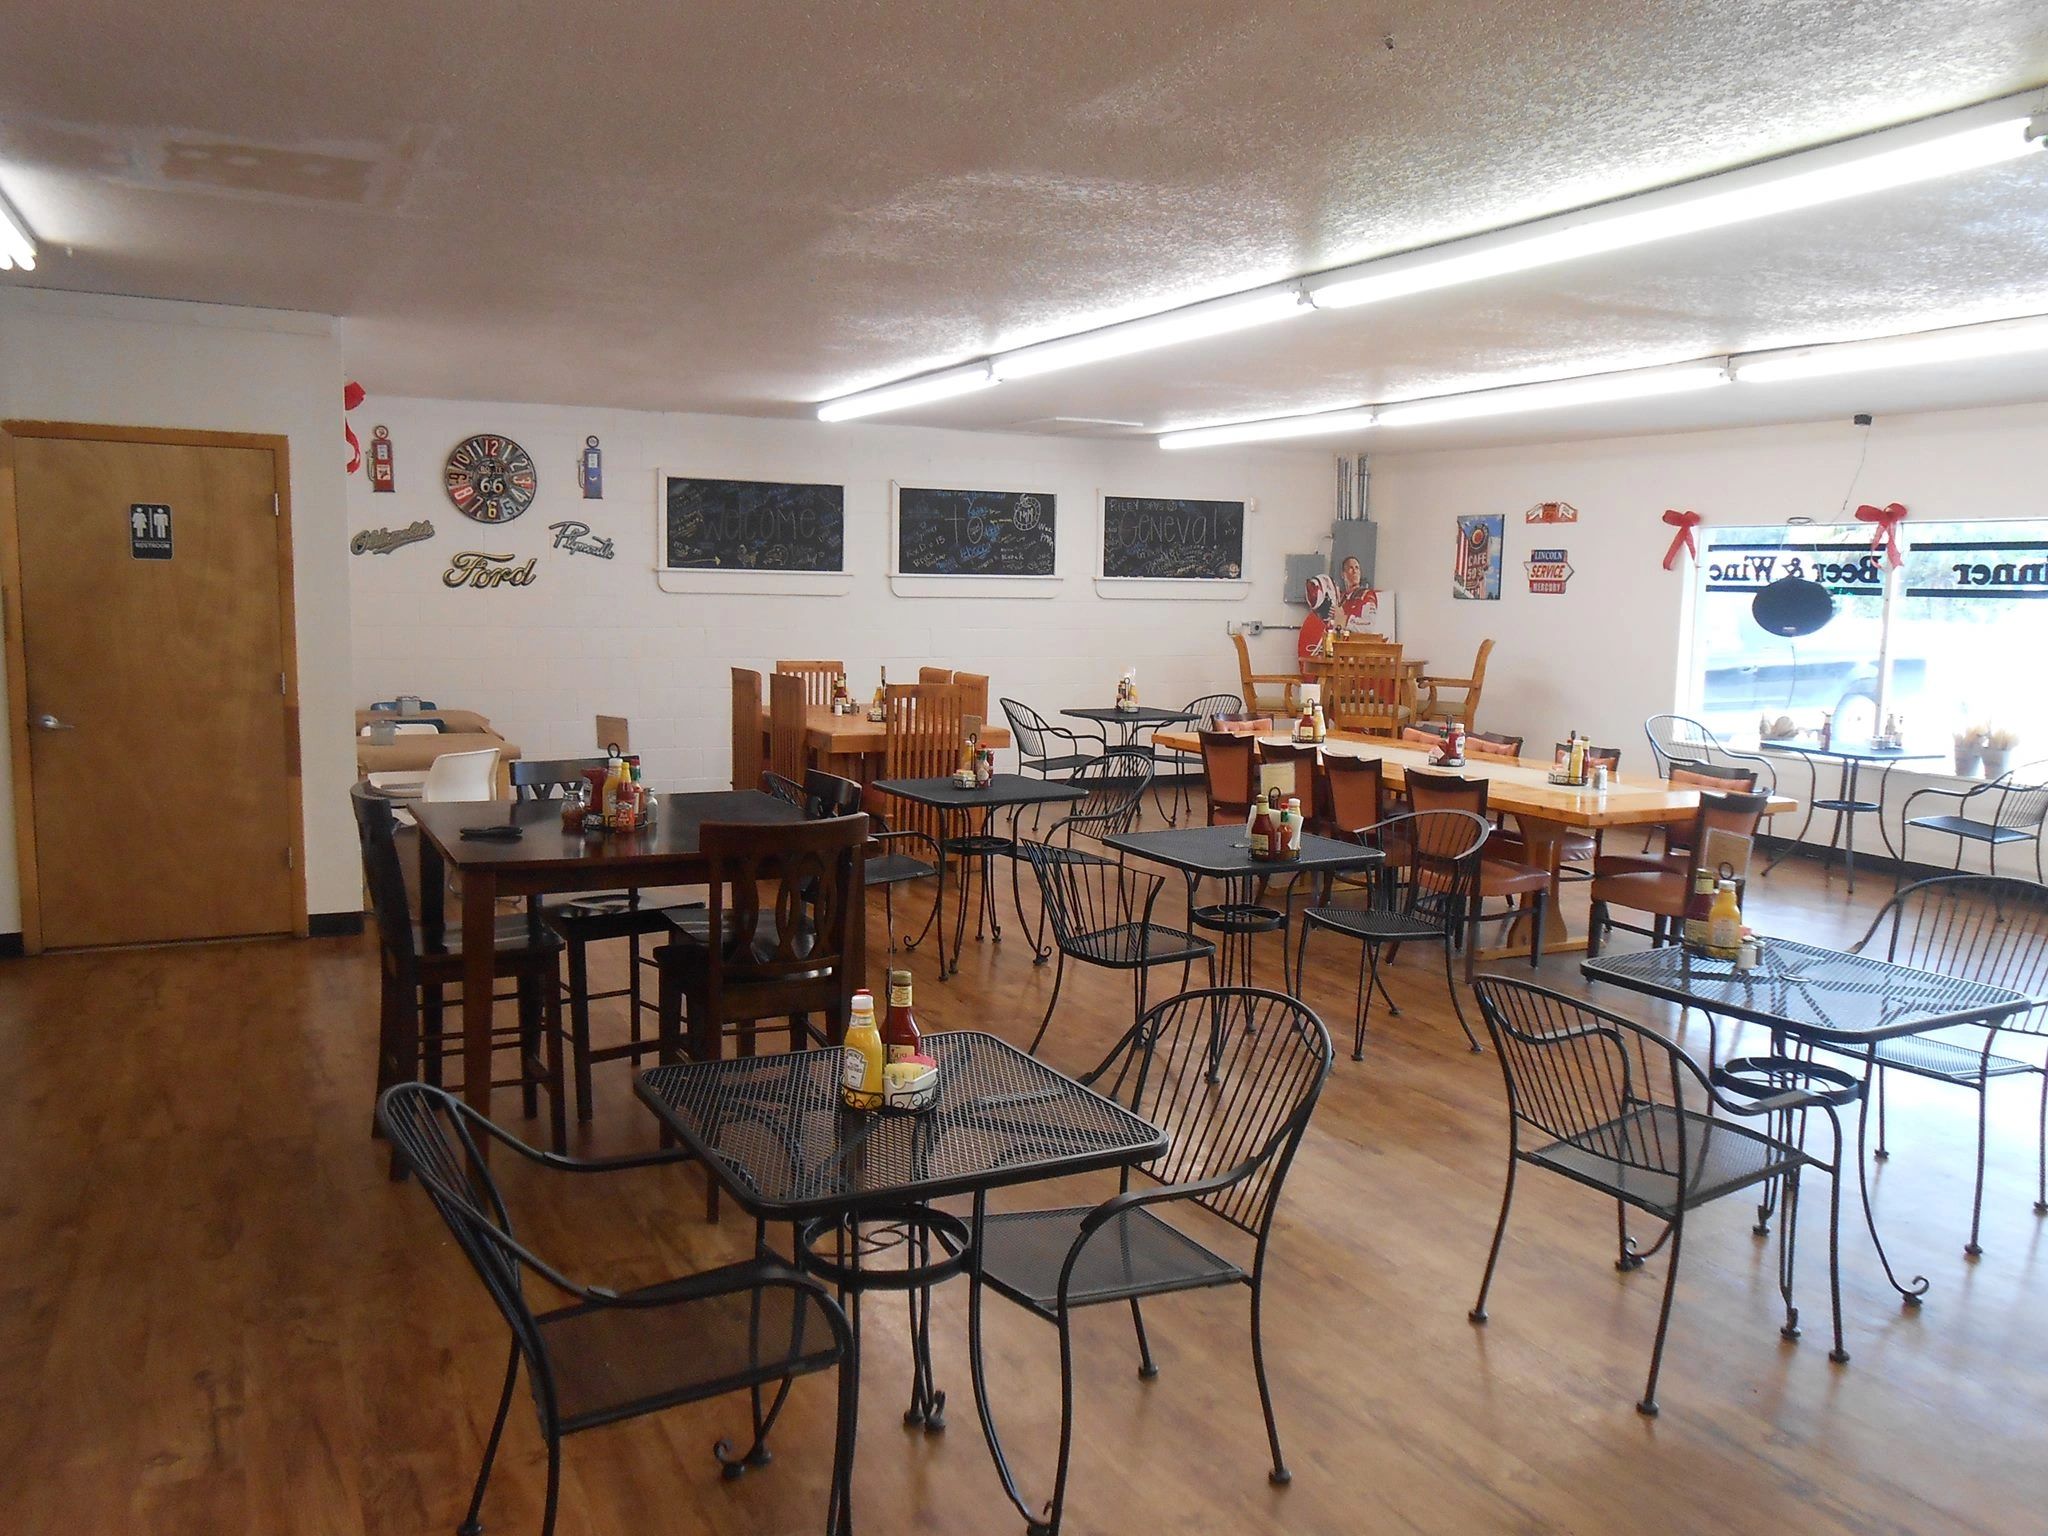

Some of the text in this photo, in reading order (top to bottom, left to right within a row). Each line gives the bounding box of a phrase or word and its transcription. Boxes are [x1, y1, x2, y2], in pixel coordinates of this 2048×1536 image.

[466, 441, 484, 461] 11
[485, 439, 498, 456] 12
[453, 453, 470, 470] 10
[480, 478, 504, 493] 66
[548, 520, 614, 560] Plymouth
[1468, 552, 1487, 567] CAFE
[1534, 551, 1563, 561] LINCOLN
[443, 551, 537, 589] Ford
[1530, 564, 1565, 579] SERVICE
[1533, 583, 1560, 593] MERCURY
